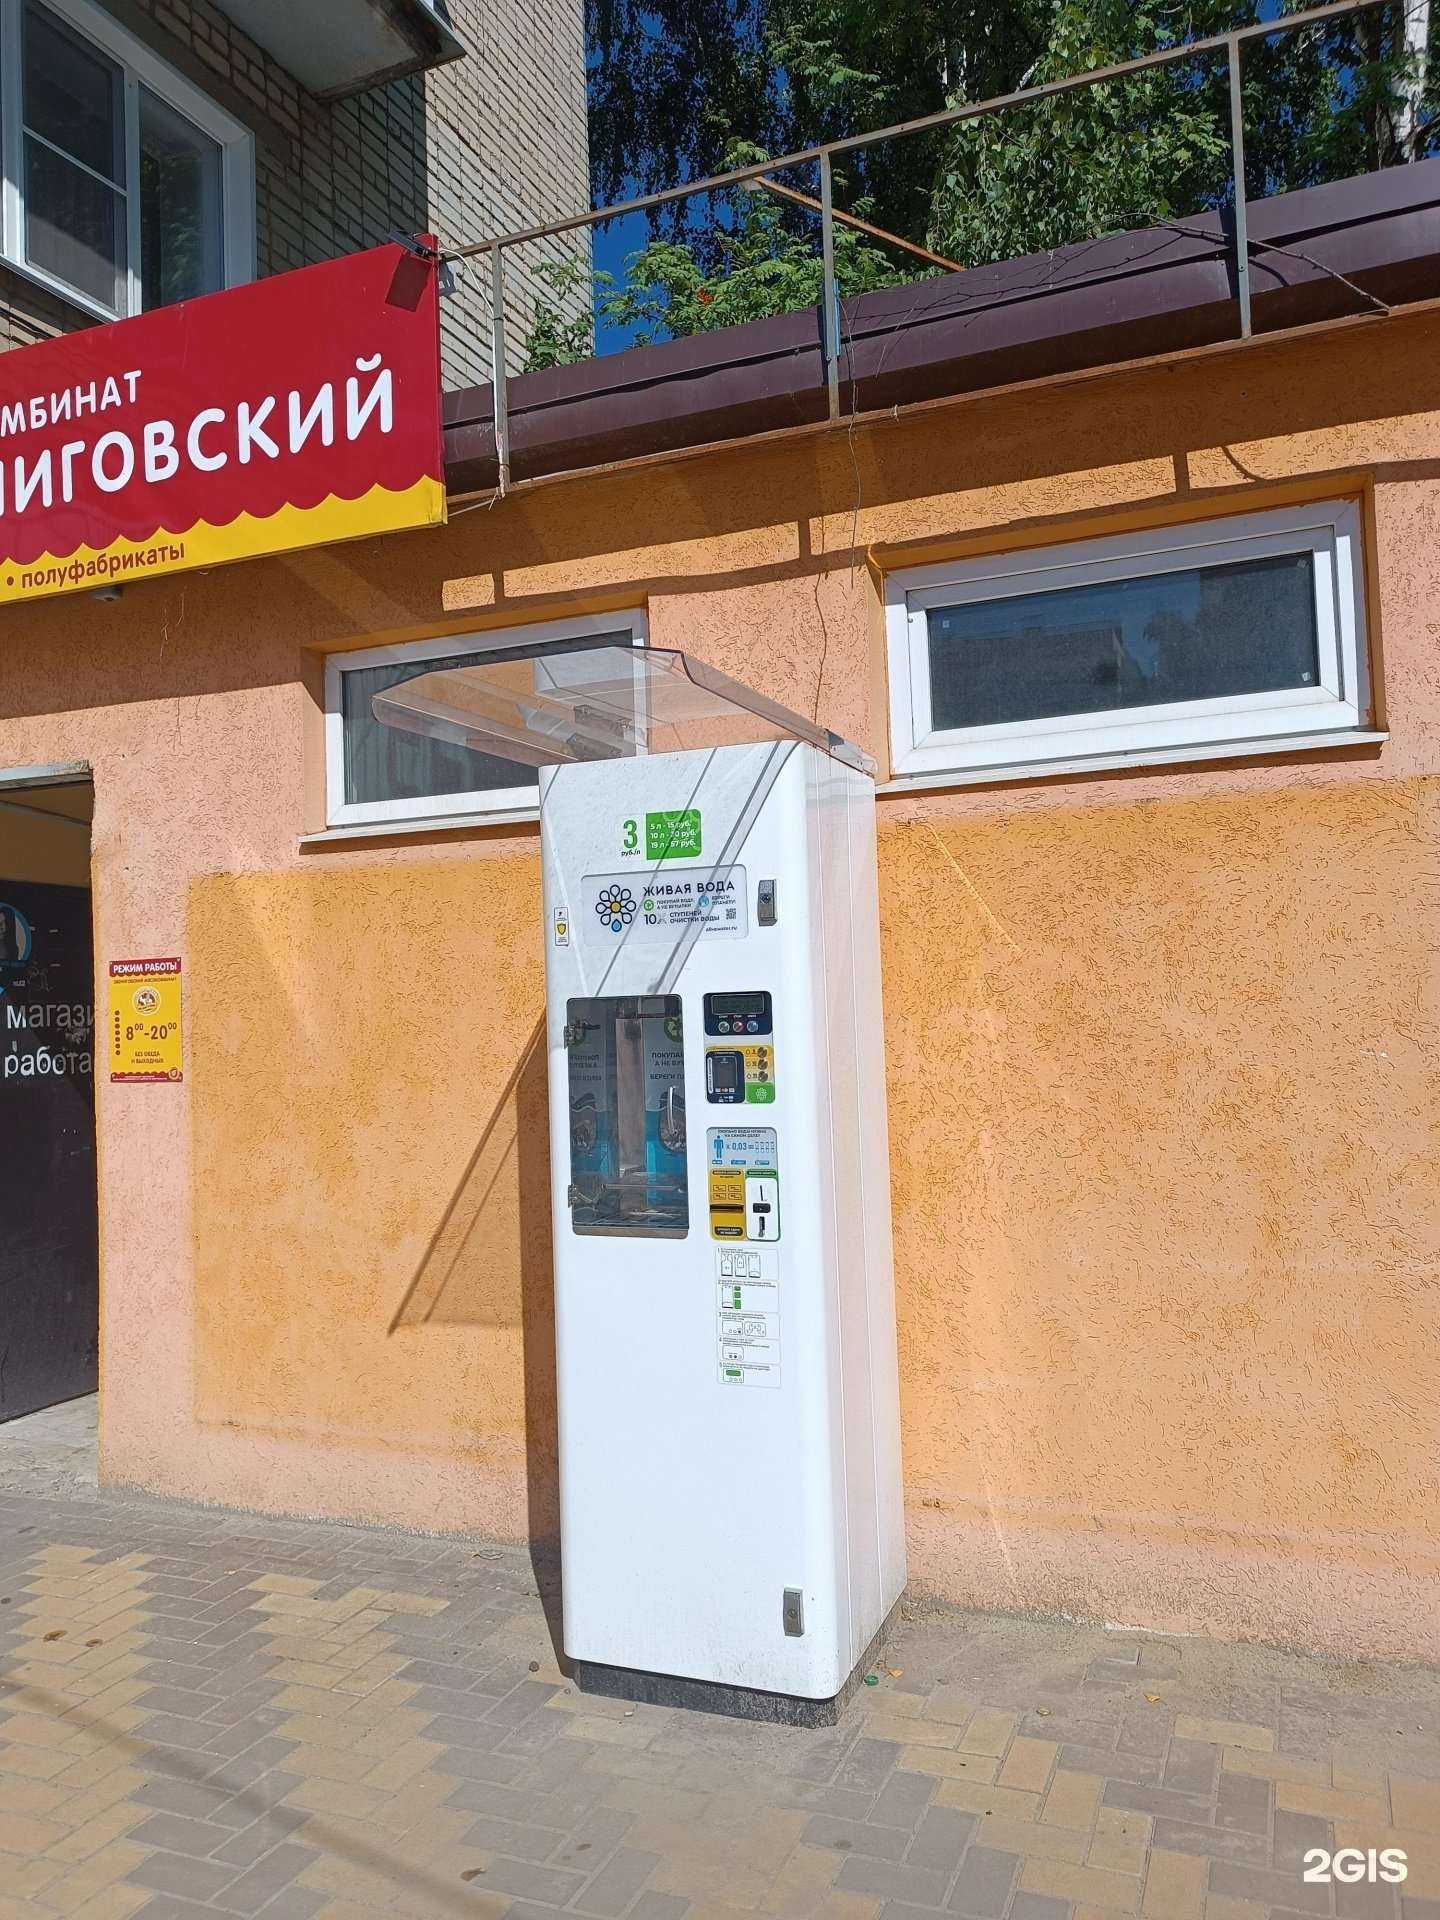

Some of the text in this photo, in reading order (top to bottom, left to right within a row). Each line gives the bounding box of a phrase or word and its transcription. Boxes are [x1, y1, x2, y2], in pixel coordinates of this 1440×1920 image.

[0, 354, 392, 516] ИГОВСКИЙ
[22, 543, 184, 588] полуфабрикаты
[623, 820, 638, 848] 3
[642, 881, 734, 896] ЖИВАЯ ВОДА
[644, 914, 656, 924] 10
[113, 962, 177, 974] РЕЖИМ РАБОТЫ
[732, 1142, 746, 1151] 0,03
